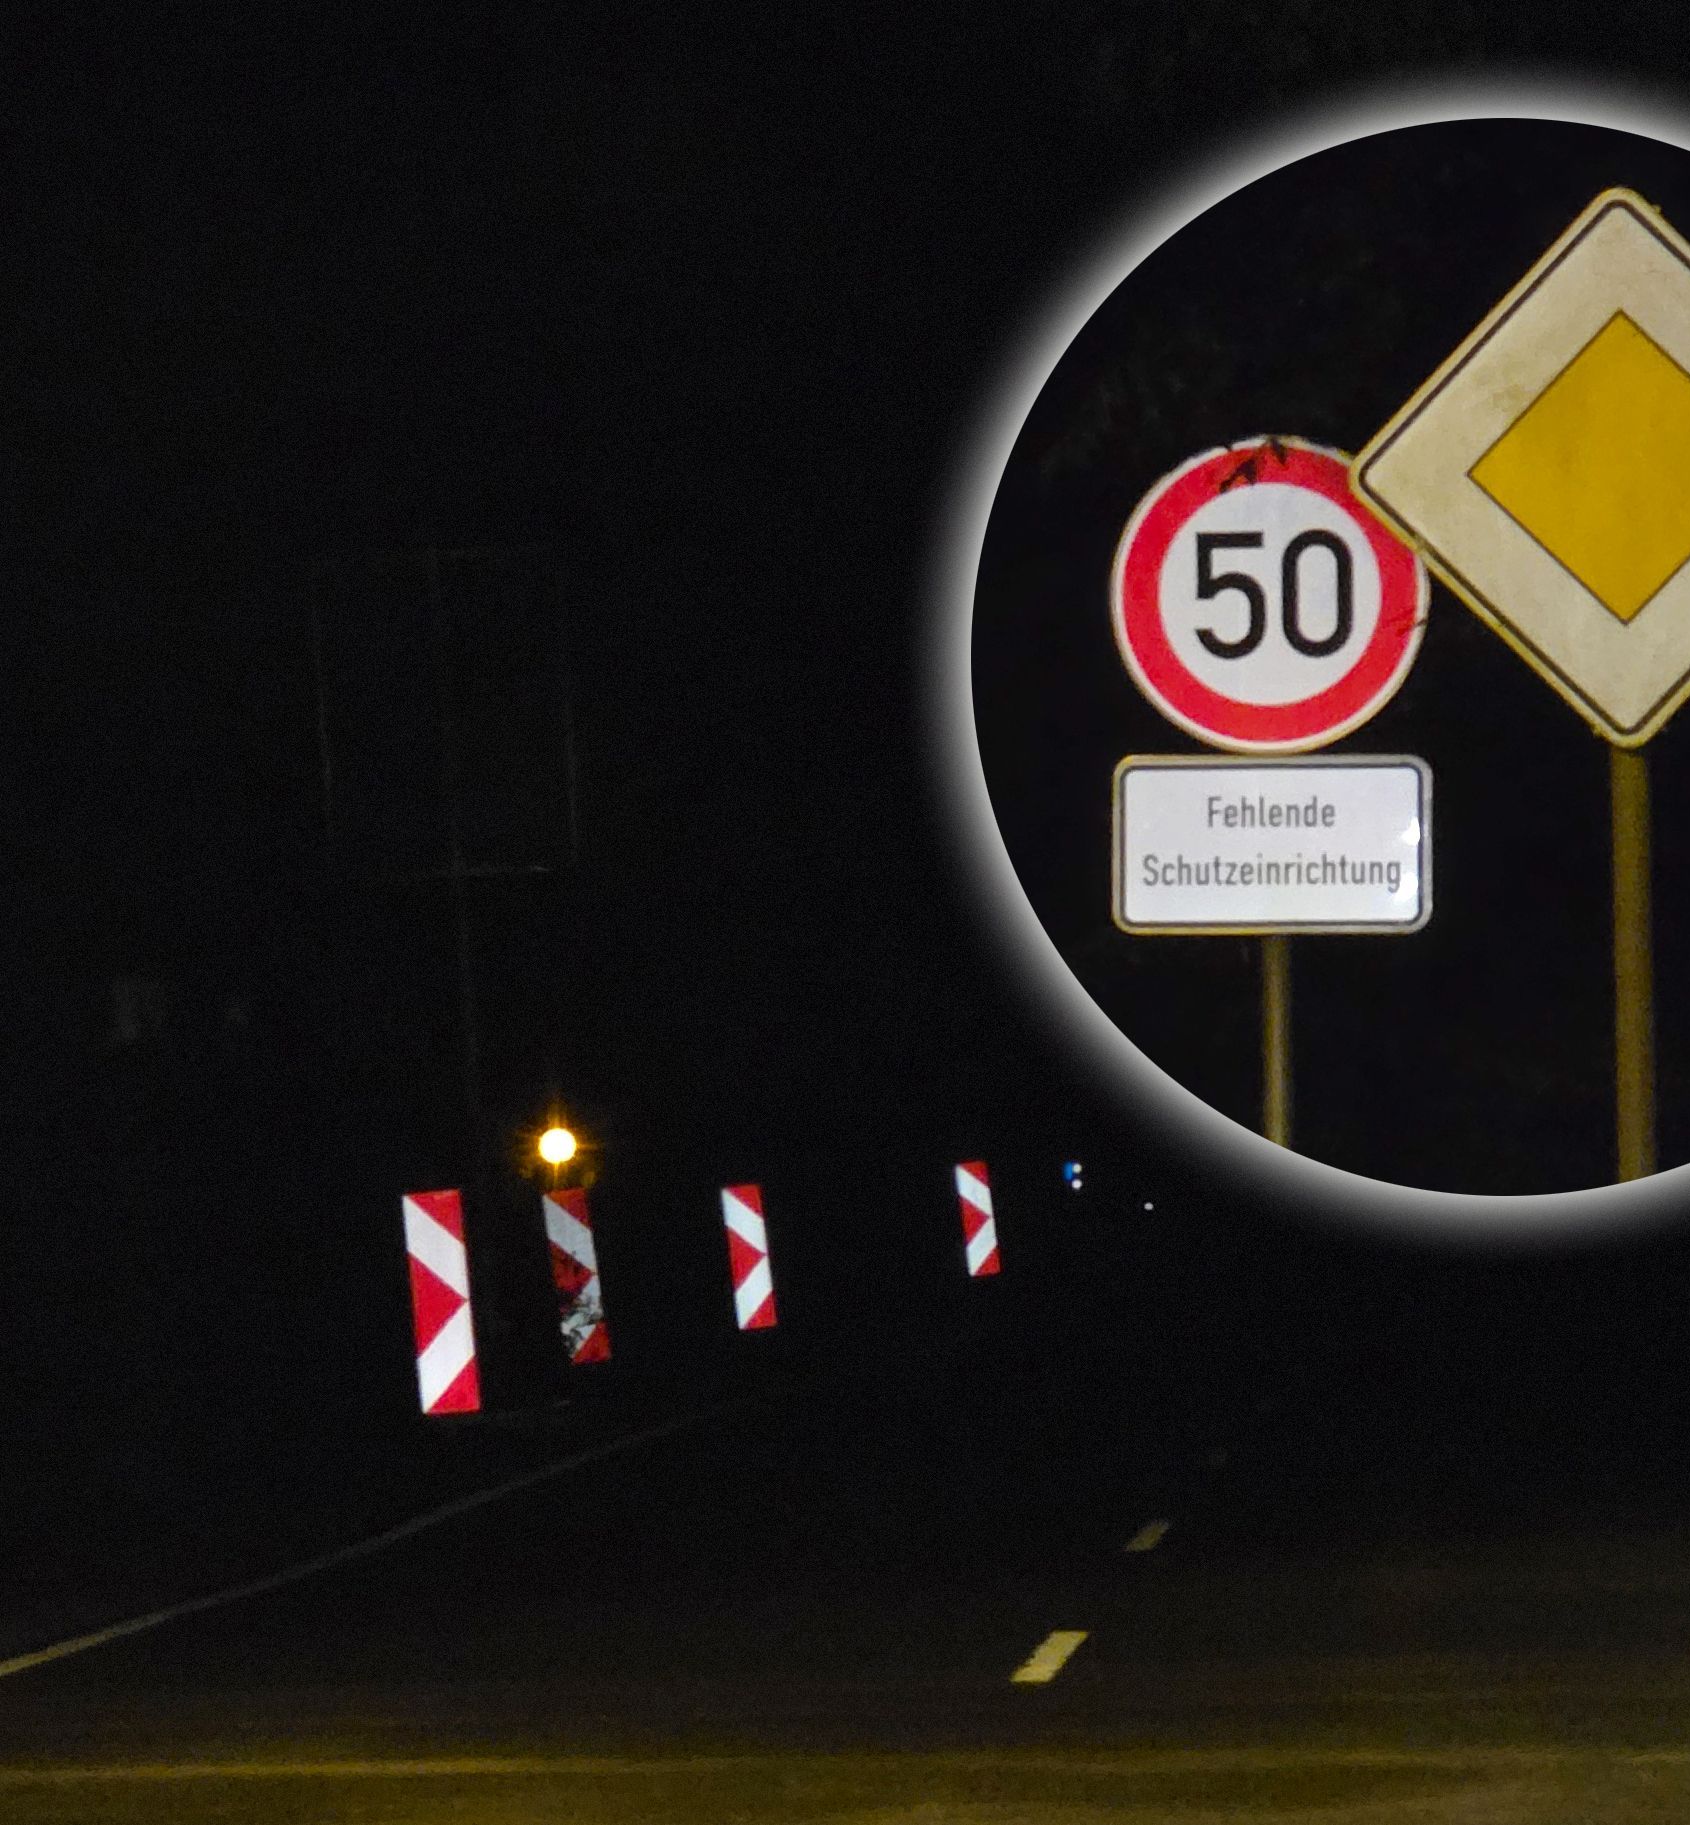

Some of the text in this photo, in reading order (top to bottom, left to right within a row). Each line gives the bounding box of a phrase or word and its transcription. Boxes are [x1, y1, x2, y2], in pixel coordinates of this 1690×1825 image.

[1195, 529, 1353, 659] 50
[1206, 796, 1336, 828] Fehlende
[1142, 853, 1403, 892] Schutzeinrichtung
